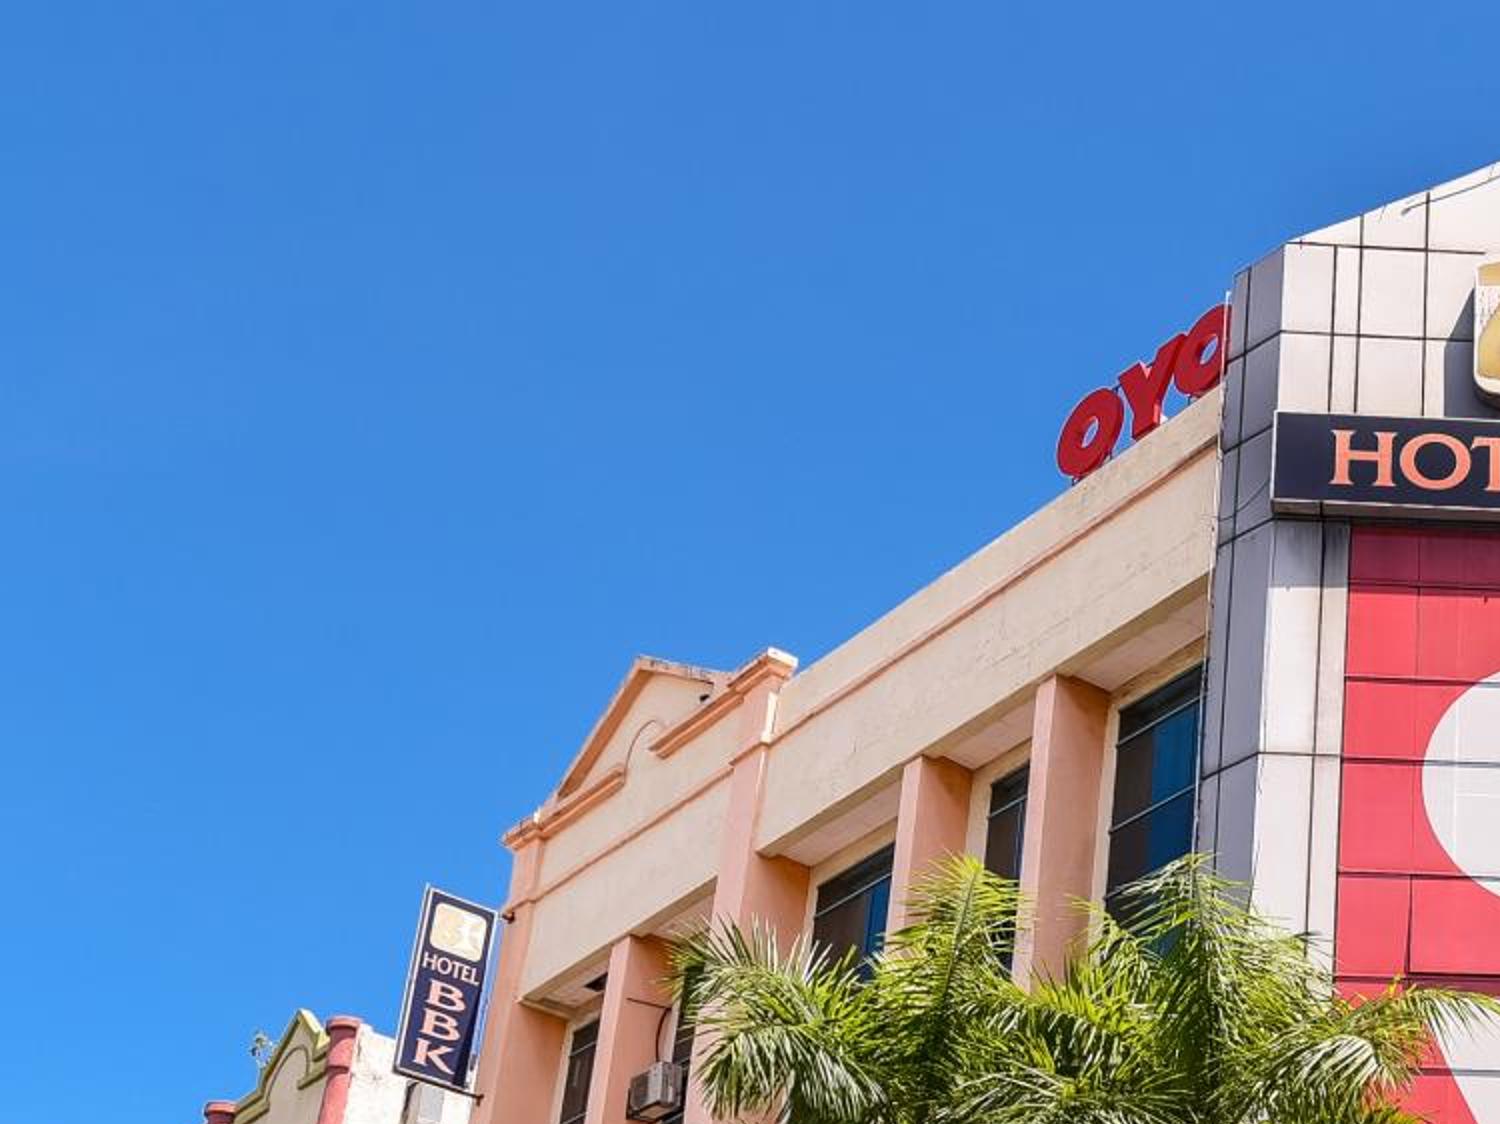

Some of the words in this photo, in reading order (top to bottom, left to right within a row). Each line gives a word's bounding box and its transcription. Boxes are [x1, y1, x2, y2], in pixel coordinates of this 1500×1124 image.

[1057, 304, 1228, 480] OYO
[422, 951, 480, 986] HOTEL
[413, 978, 466, 1076] BBK
